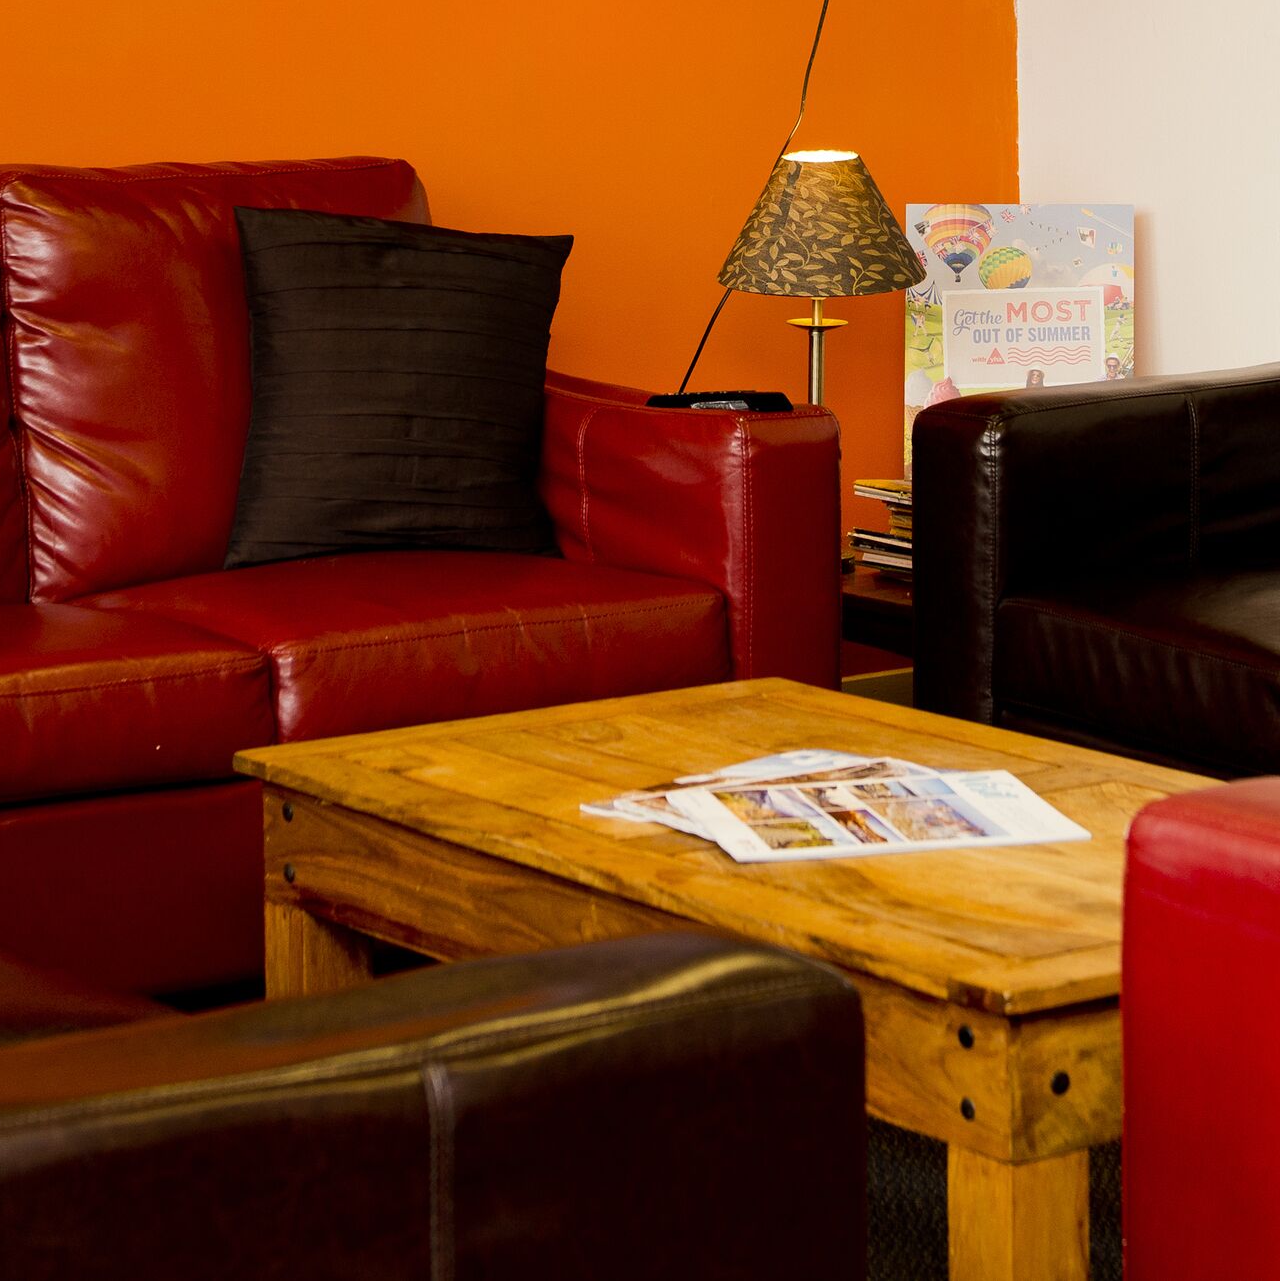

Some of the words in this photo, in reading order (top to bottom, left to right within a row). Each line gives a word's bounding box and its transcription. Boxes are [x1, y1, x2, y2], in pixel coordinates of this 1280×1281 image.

[952, 309, 979, 336] Get
[977, 309, 1003, 325] the
[1006, 300, 1092, 323] MOST
[972, 328, 1001, 344] OUT
[1005, 327, 1024, 343] OF
[1028, 325, 1091, 343] SUMMER
